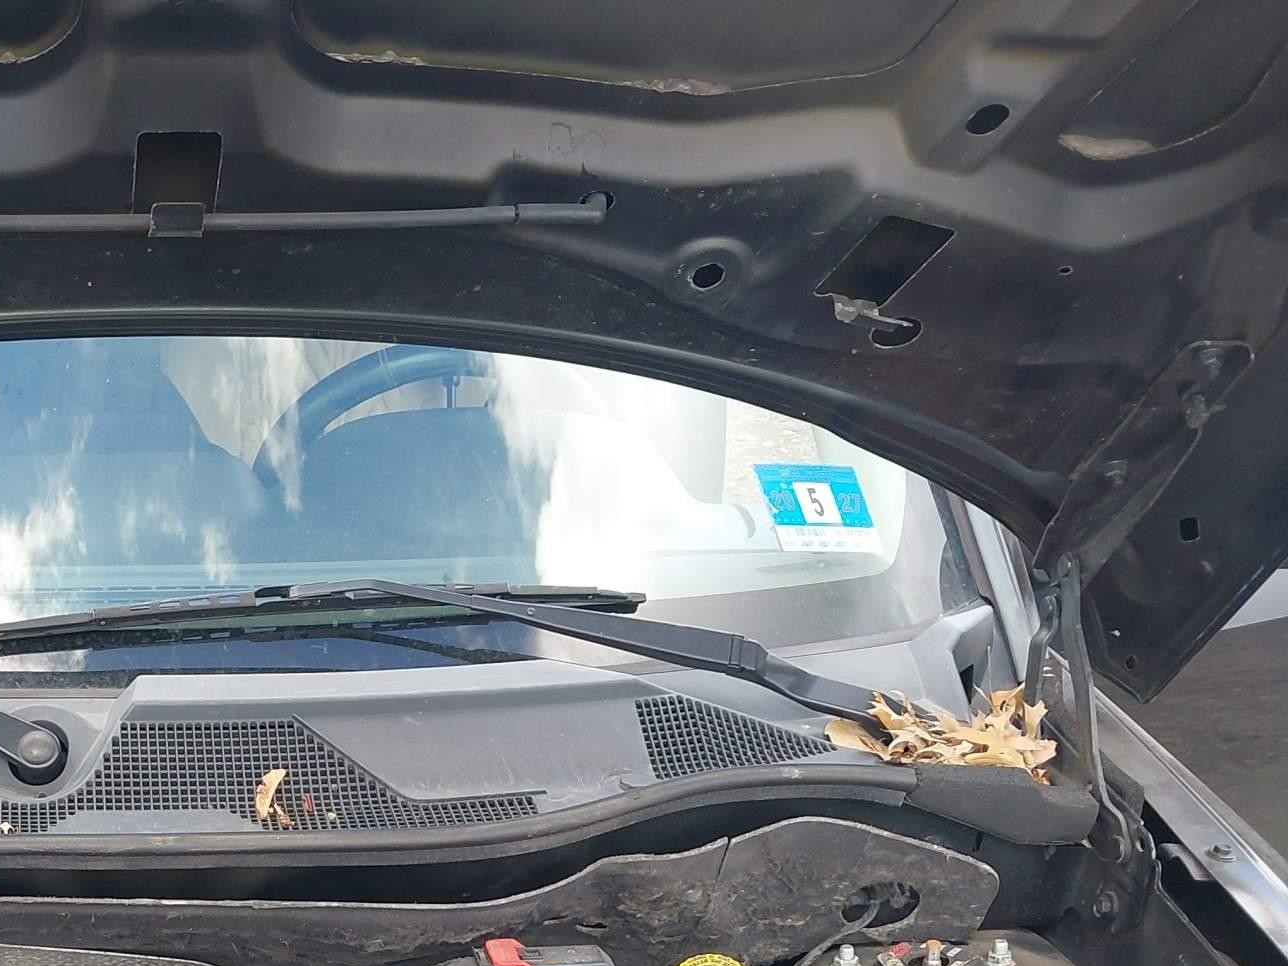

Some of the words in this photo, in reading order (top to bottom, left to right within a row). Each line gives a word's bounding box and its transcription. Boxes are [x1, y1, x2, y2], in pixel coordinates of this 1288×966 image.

[769, 488, 795, 512] 20
[806, 487, 825, 517] 5
[837, 492, 861, 513] 27
